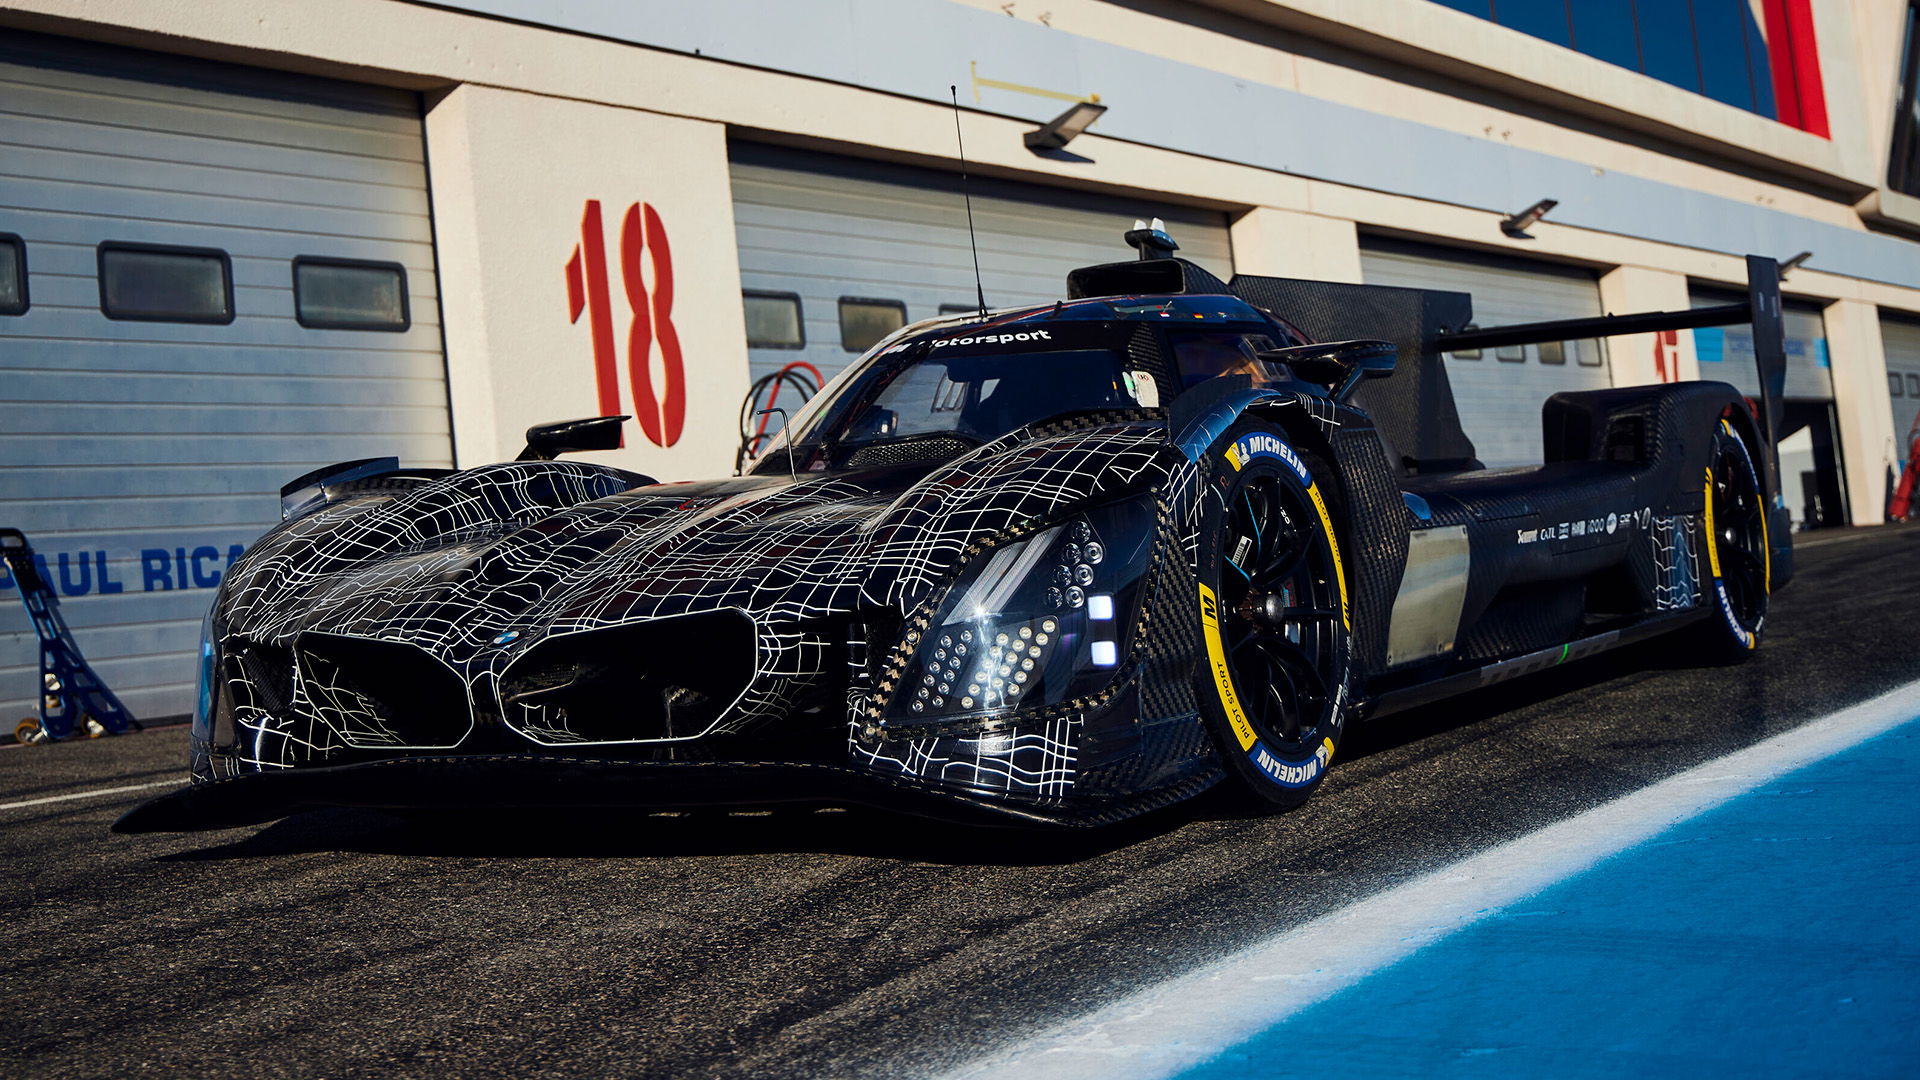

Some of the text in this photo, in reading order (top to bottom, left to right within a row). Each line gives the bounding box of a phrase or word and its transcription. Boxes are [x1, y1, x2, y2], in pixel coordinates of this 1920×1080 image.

[565, 199, 686, 449] 18
[1248, 435, 1308, 479] MICHELIN
[0, 549, 123, 597] AUL
[1201, 594, 1217, 621] M
[1216, 661, 1250, 739] PILOT SPORT
[1256, 749, 1318, 784] MICHELIN
